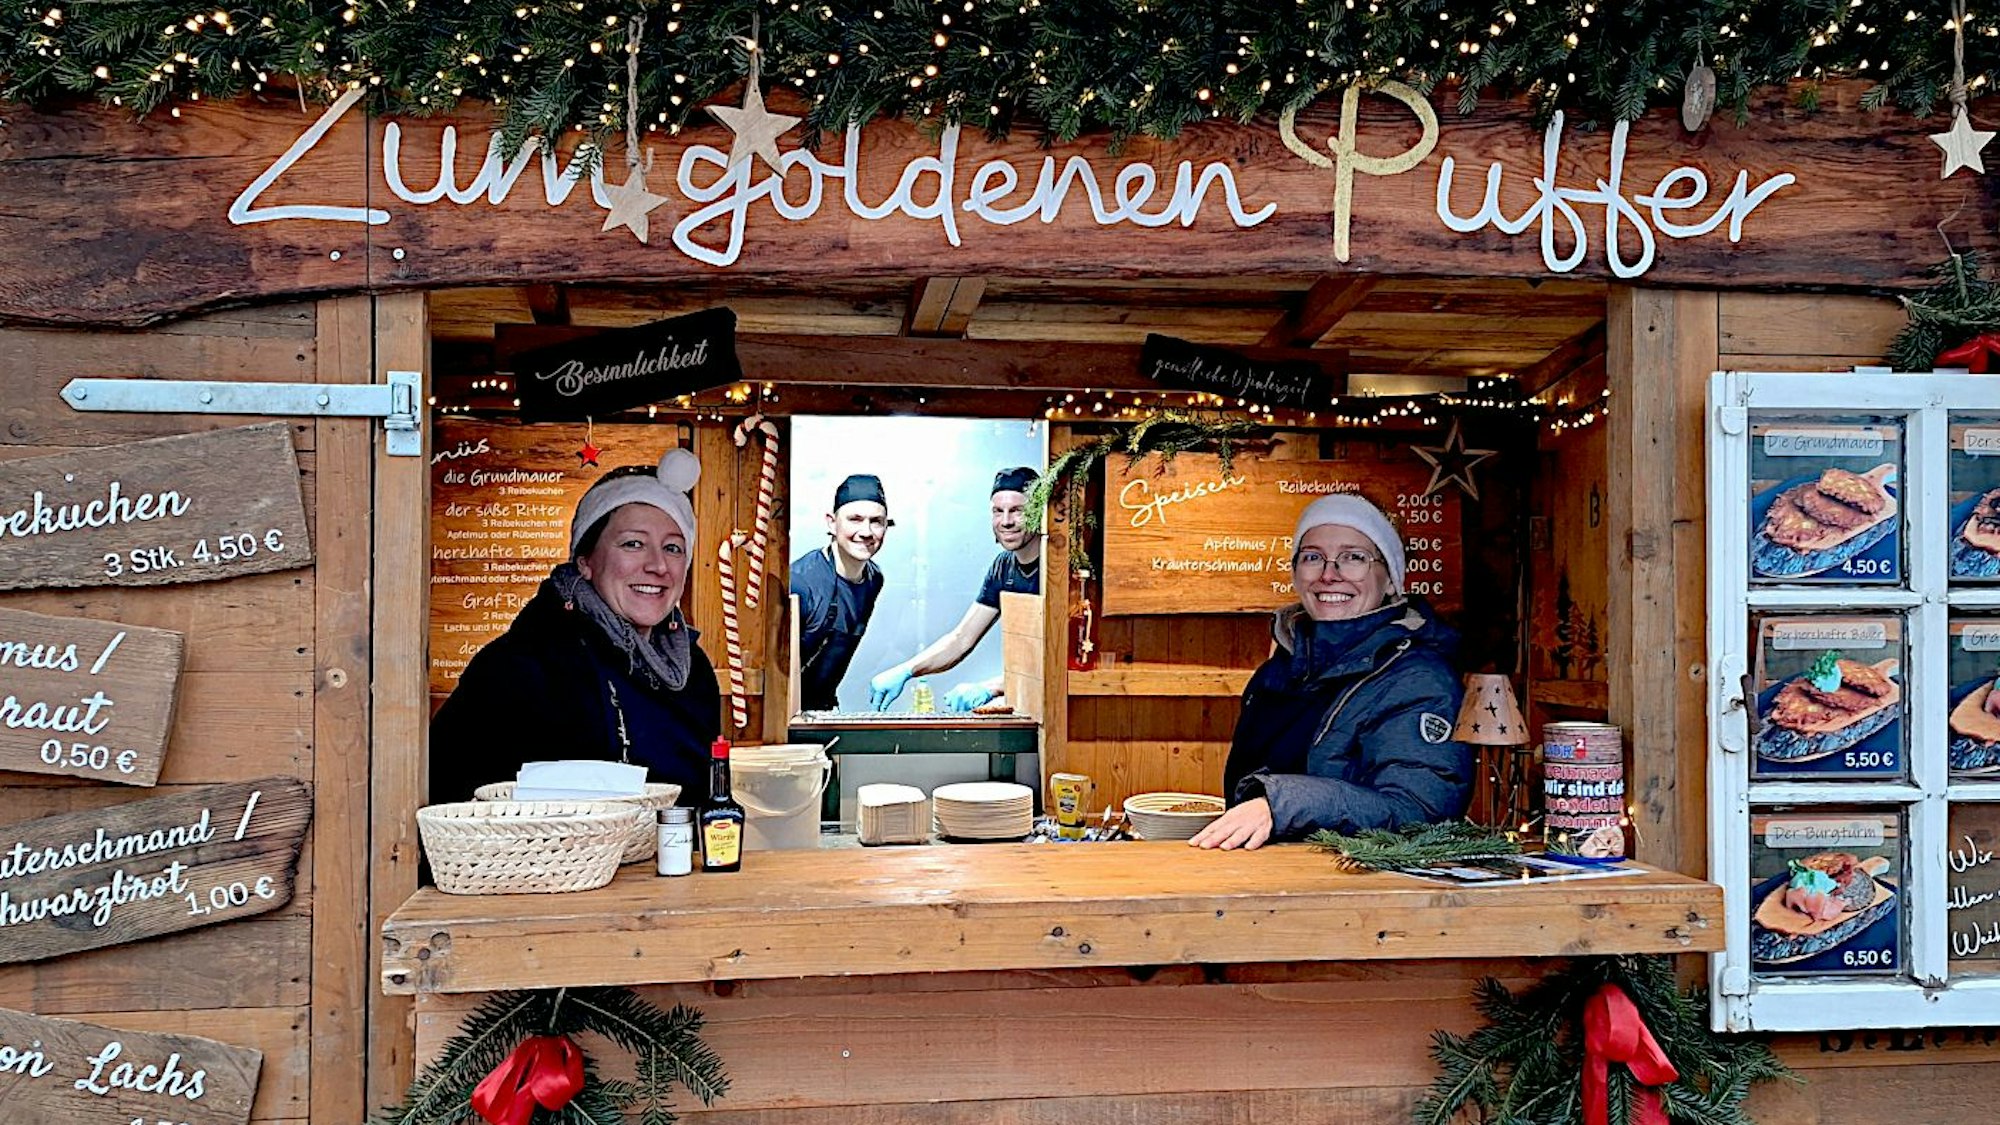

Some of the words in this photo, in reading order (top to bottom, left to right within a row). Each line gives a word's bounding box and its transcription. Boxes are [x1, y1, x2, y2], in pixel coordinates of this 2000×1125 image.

[229, 86, 614, 224] Zum
[671, 110, 1277, 267] goldenen
[1279, 80, 1796, 278] Puffer
[535, 337, 709, 396] Besinnlichkeit
[1767, 435, 1790, 449] Die
[1795, 435, 1882, 451] Grundmauer
[1968, 434, 1992, 448] Der
[444, 469, 466, 484] die
[470, 468, 564, 486] Grundmauer
[499, 487, 506, 496] 3
[508, 486, 564, 496] Reibekuchen
[1276, 479, 1360, 494] Reibekuchen
[445, 502, 471, 517] der
[512, 503, 564, 517] Ritter
[1119, 475, 1246, 528] Speisen
[482, 519, 489, 528] 3
[490, 518, 548, 528] Reibekuchen
[1432, 510, 1443, 524] €
[447, 530, 489, 541] Apfelmus
[490, 530, 510, 540] oder
[433, 544, 514, 560] herzhafte
[520, 544, 564, 560] Bauer
[1203, 536, 1266, 552] Apfelmus
[1432, 538, 1443, 552] €
[103, 552, 123, 577] 3
[130, 546, 185, 573] Stk.
[192, 532, 258, 564] 4,50
[263, 529, 285, 552] €
[483, 563, 489, 572] 3
[490, 562, 548, 572] Reibekuchen
[1432, 558, 1443, 572] €
[1842, 559, 1878, 575] 4,50
[1880, 559, 1891, 574] €
[488, 574, 509, 583] oder
[1433, 581, 1443, 595] €
[462, 591, 502, 609] Graf
[483, 611, 489, 620] 2
[472, 623, 489, 632] und
[40, 739, 109, 770] 0,50
[116, 749, 138, 773] €
[1845, 752, 1880, 768] 5,50
[1882, 752, 1894, 767] €
[1568, 779, 1605, 796] sind
[1772, 826, 1801, 840] Der
[1805, 826, 1877, 843] Burgturm
[1949, 835, 1992, 873] Wir
[184, 882, 249, 916] 1,00
[254, 876, 276, 899] €
[1843, 951, 1878, 967] 6,50
[1880, 950, 1892, 965] €
[74, 1041, 207, 1100] Lachs
